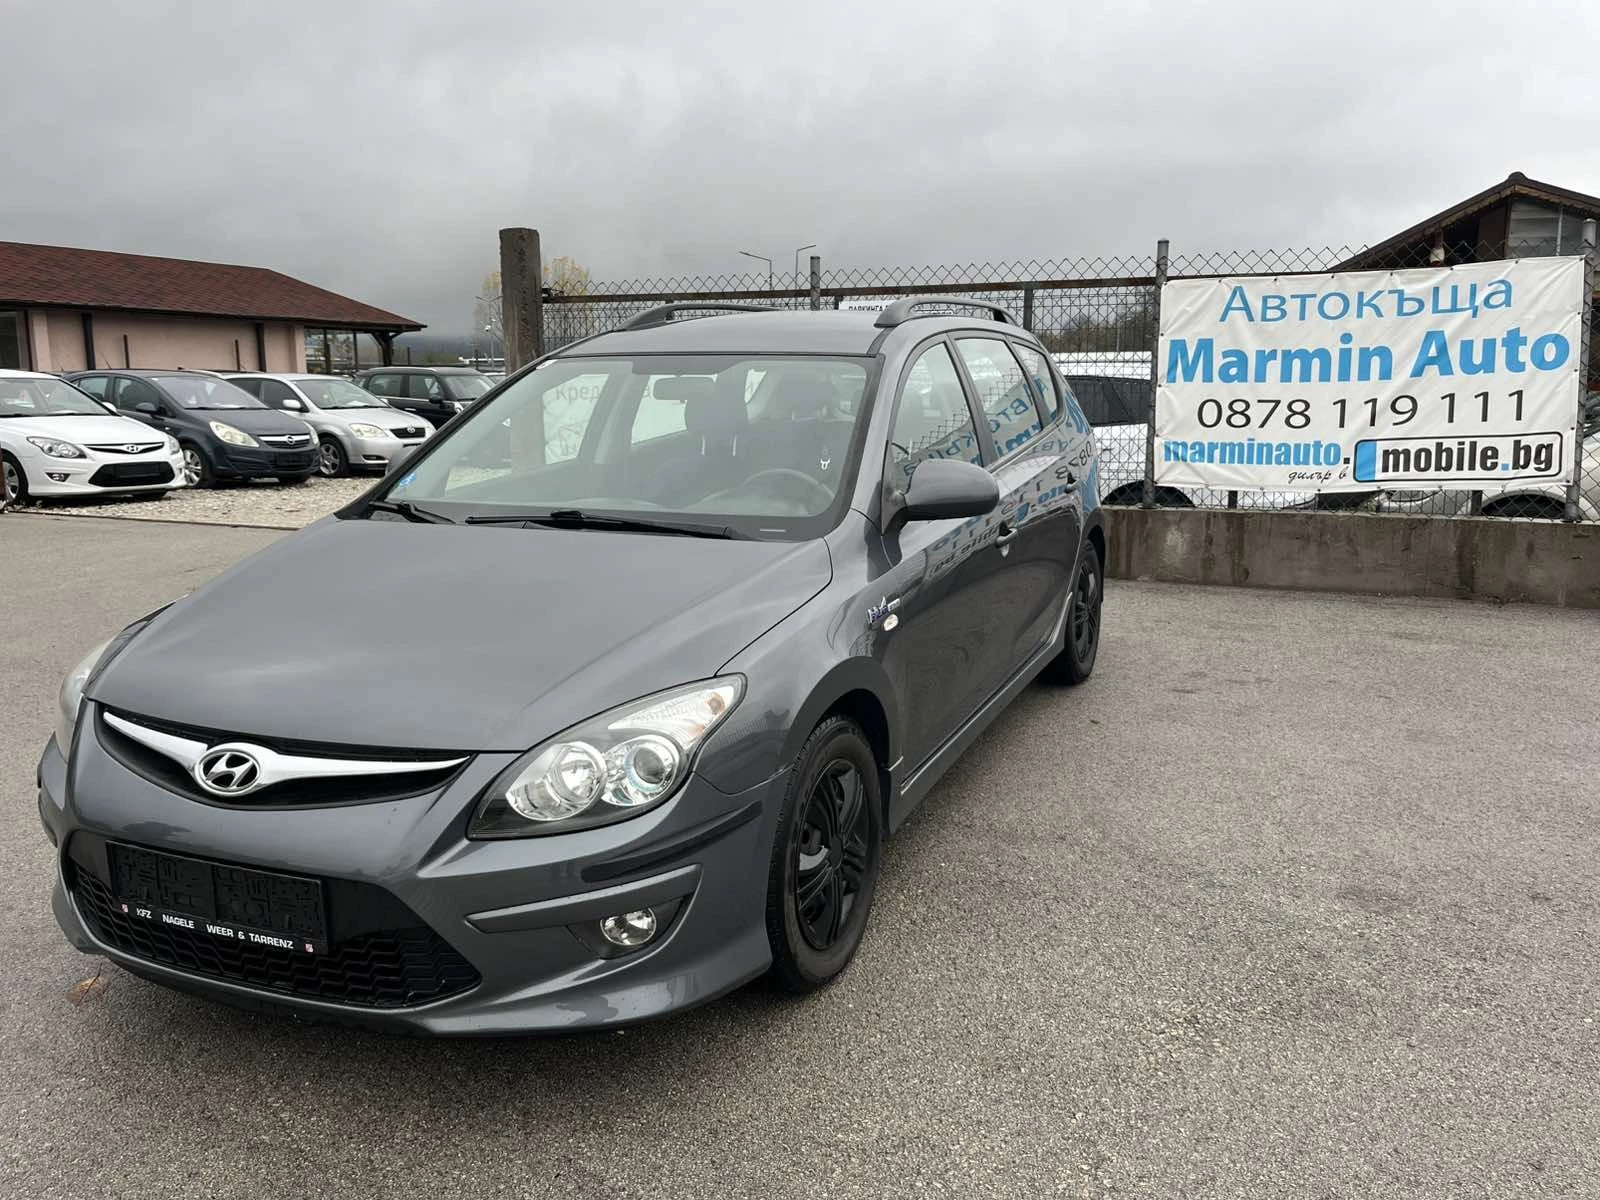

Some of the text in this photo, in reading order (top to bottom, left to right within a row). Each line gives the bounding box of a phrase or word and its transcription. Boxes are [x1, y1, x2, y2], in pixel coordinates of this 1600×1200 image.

[1219, 279, 1513, 322] Автокъща
[1166, 326, 1570, 384] Marmin Auto
[1198, 389, 1525, 429] 0878 119 111
[1164, 438, 1554, 473] marminauto. mobile.bg
[1288, 470, 1332, 484] дилър
[162, 914, 195, 929] NAGELE
[206, 924, 234, 938] WEER
[238, 931, 246, 940] &
[249, 933, 295, 949] TARRENZ
